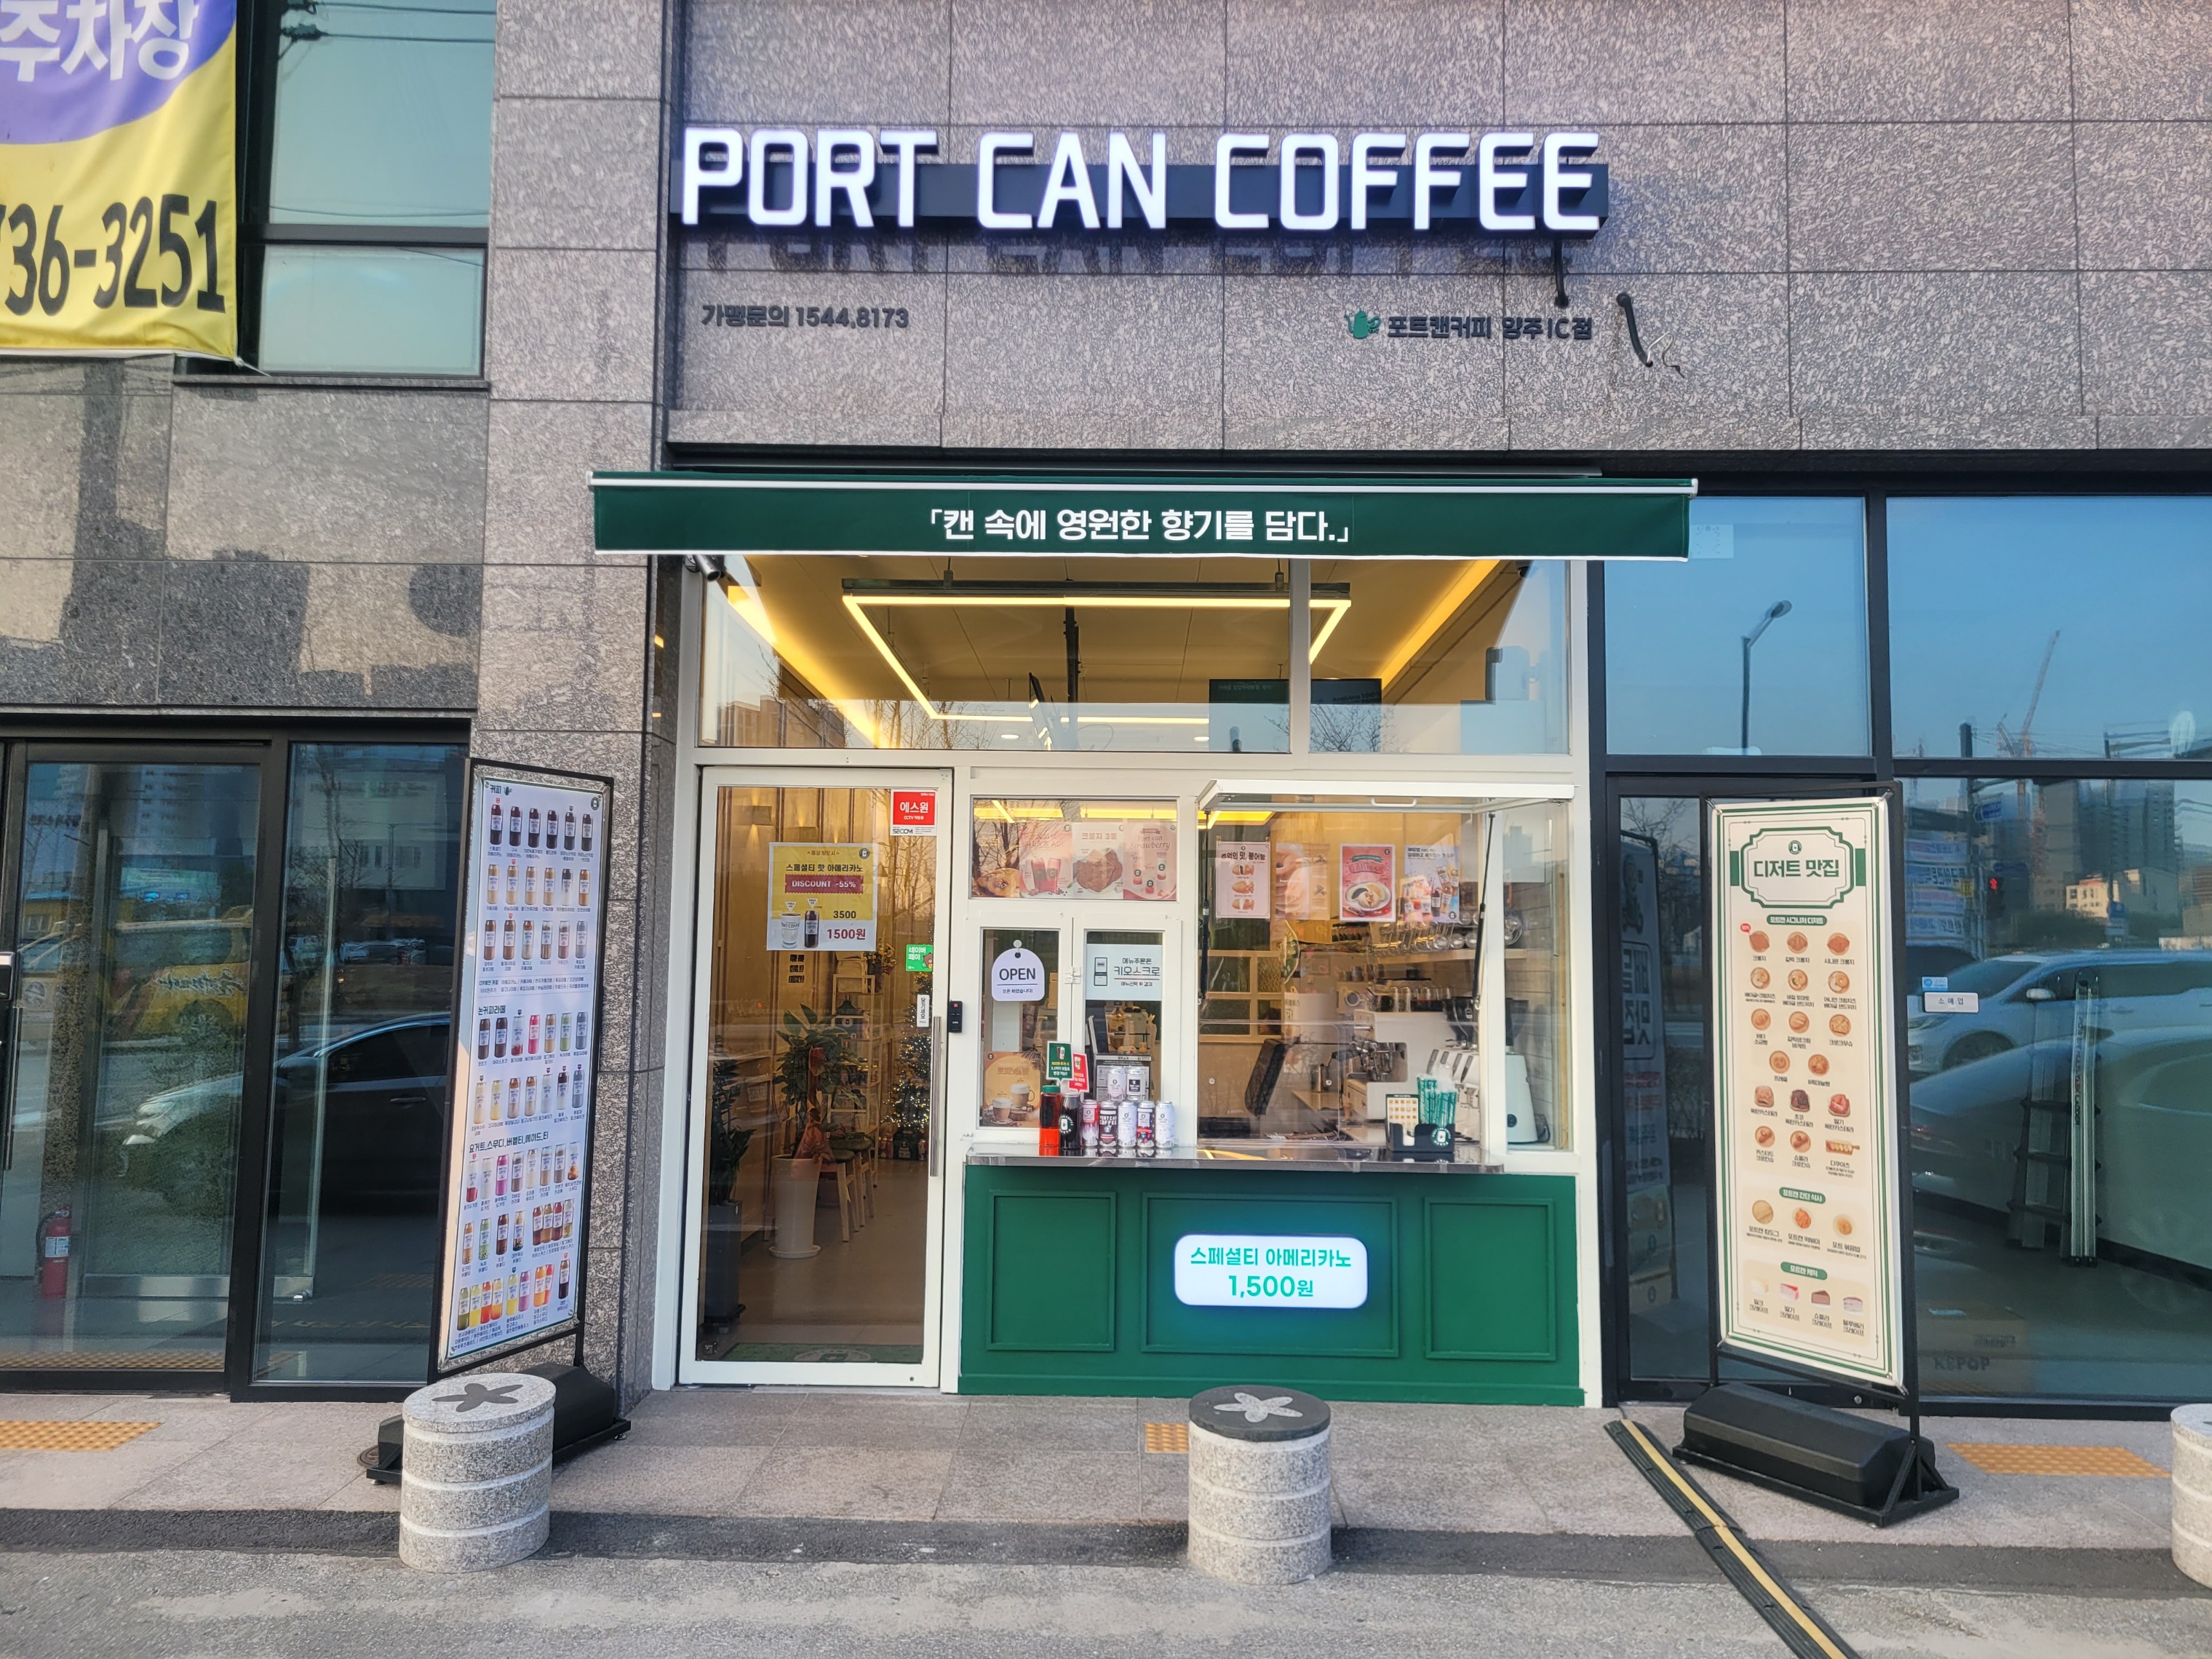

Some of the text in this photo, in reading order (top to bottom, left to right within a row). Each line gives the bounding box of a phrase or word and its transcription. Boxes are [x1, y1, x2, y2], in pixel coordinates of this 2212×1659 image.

[0, 0, 200, 82] 주차장
[683, 127, 1599, 231] PORT CAN COFFEE
[0, 194, 226, 317] 36-3251
[701, 304, 910, 329] 가맹문의 1544.8173
[1387, 315, 1492, 339] 포트캔커피
[984, 509, 1046, 541] 속에
[1057, 509, 1152, 541] 영원한
[1162, 509, 1254, 541] 향기를
[899, 801, 929, 813] 에스원
[1129, 841, 1171, 851] Strawberry
[1249, 851, 1265, 861] 붕어빵
[786, 864, 864, 872] 스페셜티 핫 아메리카노
[1754, 859, 1839, 878] 디저트 맛집
[835, 880, 856, 888] -55%
[833, 910, 856, 919] 3500
[827, 928, 866, 940] 1500원
[999, 968, 1036, 980] OPEN
[1114, 966, 1161, 976] 키오스크로
[1190, 1246, 1351, 1268] 스페셜티 아메리카노
[1228, 1275, 1314, 1298] 1,500원
